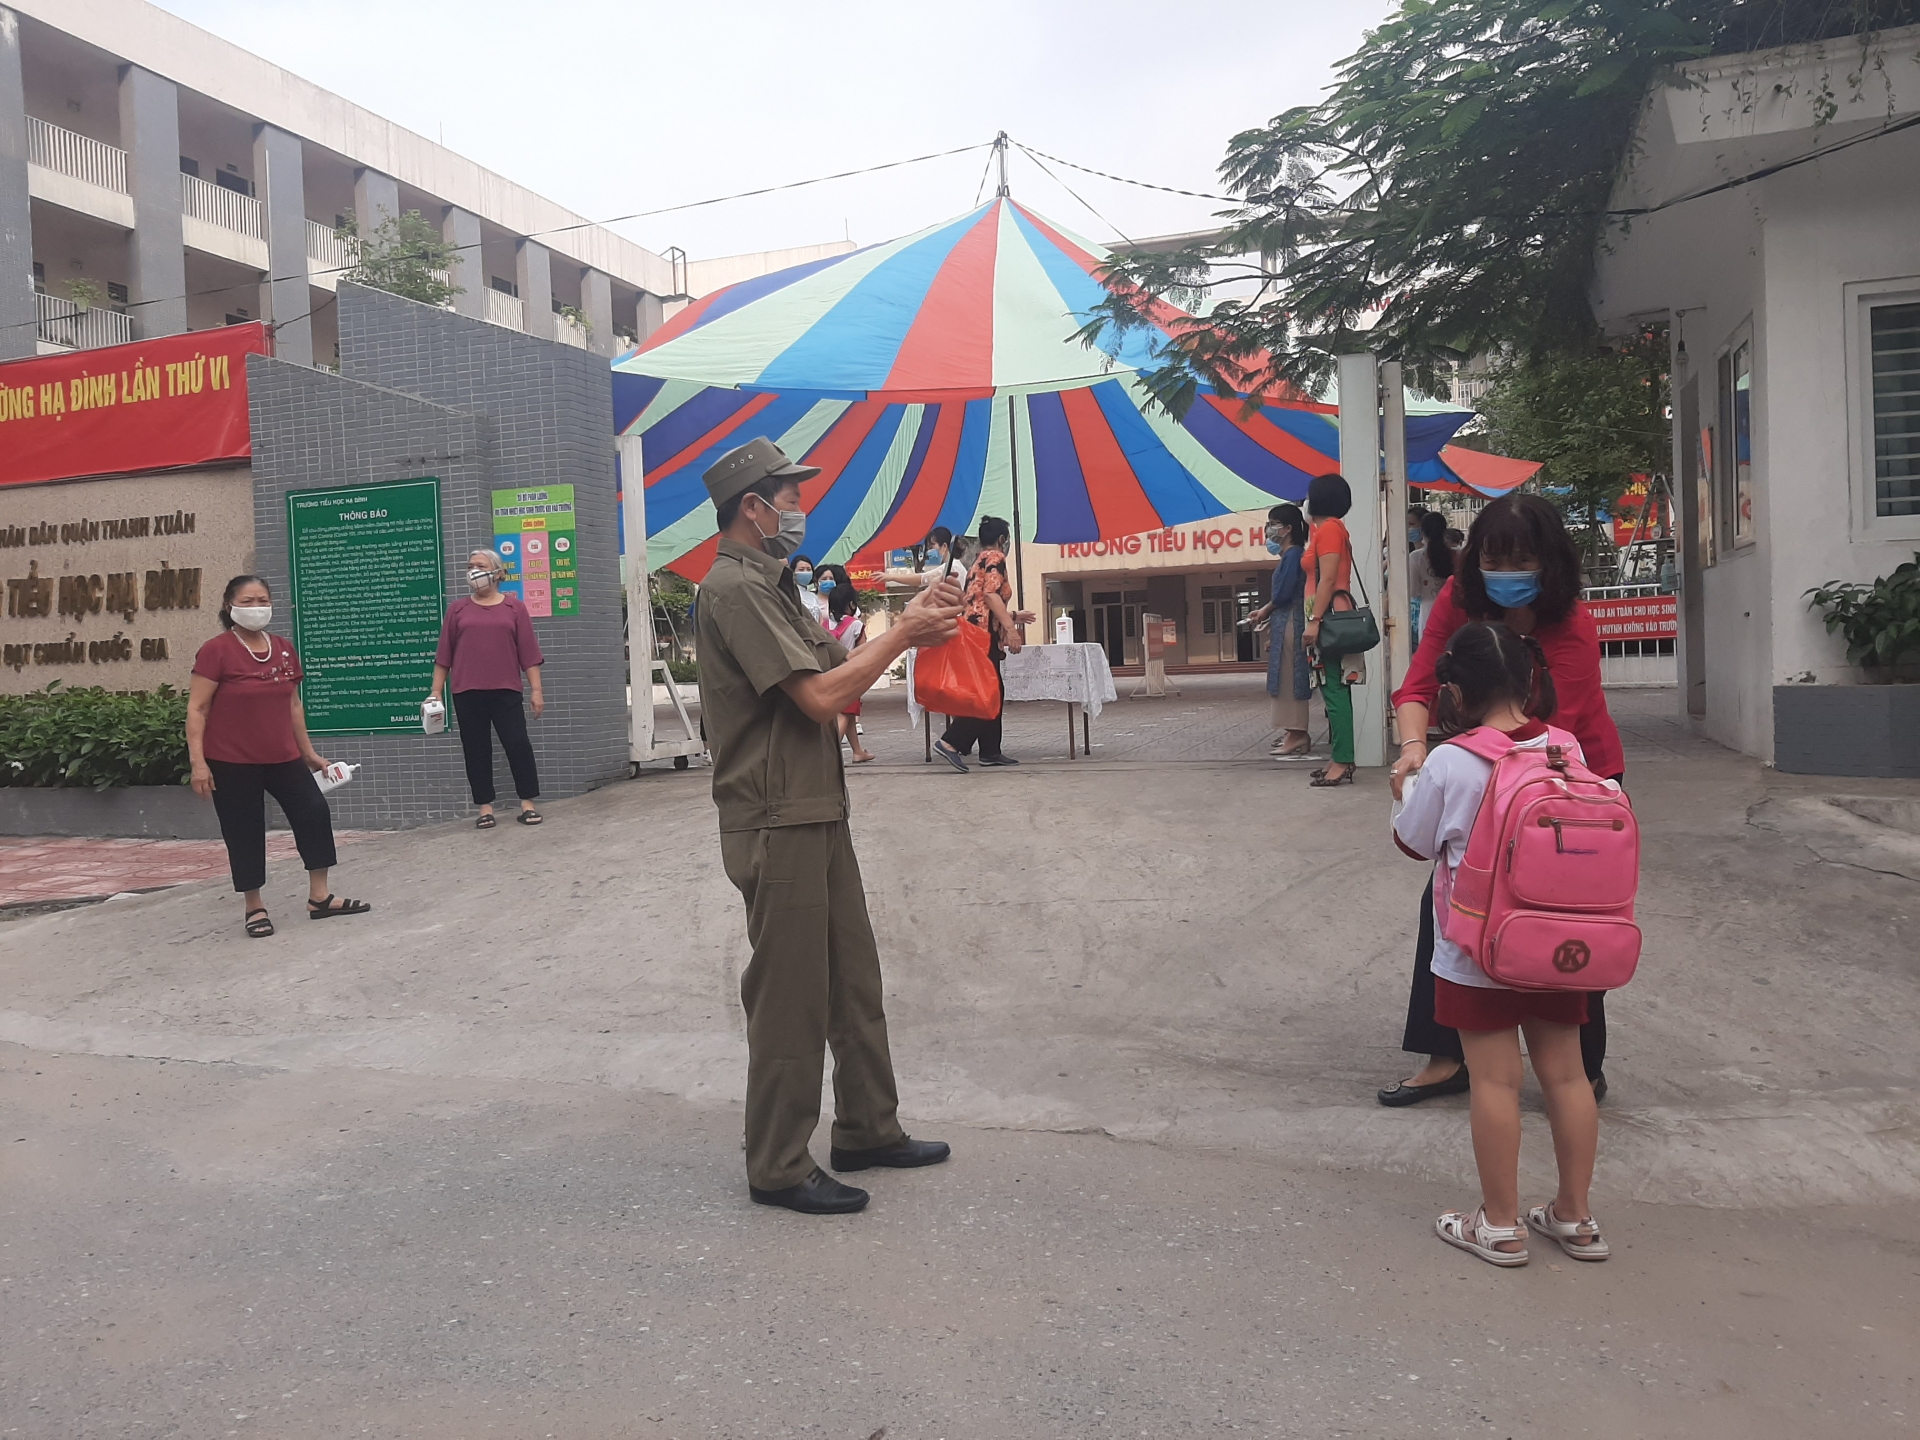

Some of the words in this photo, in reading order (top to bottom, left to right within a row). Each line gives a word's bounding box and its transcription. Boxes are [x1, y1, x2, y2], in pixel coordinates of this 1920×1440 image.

[40, 382, 65, 421] HẠ
[71, 372, 116, 412] ĐÌNH
[122, 357, 160, 404] LẦN
[166, 352, 206, 397] THỨ
[210, 356, 230, 390] VI
[339, 510, 368, 521] THÔNG
[370, 508, 388, 518] BÁO
[29, 521, 58, 546] DÂN
[61, 518, 100, 546] QUẬN
[101, 516, 150, 540] THANH
[153, 510, 196, 536] XUÂN
[1193, 528, 1243, 553] HỌC
[1250, 527, 1266, 546] H
[1607, 607, 1615, 617] AN
[1634, 605, 1646, 616] CHO
[1648, 605, 1659, 617] HỌC
[1662, 604, 1676, 614] SINH
[1624, 620, 1644, 632] KHÔNG
[1646, 621, 1657, 632] VÀO
[140, 638, 169, 661] GIA
